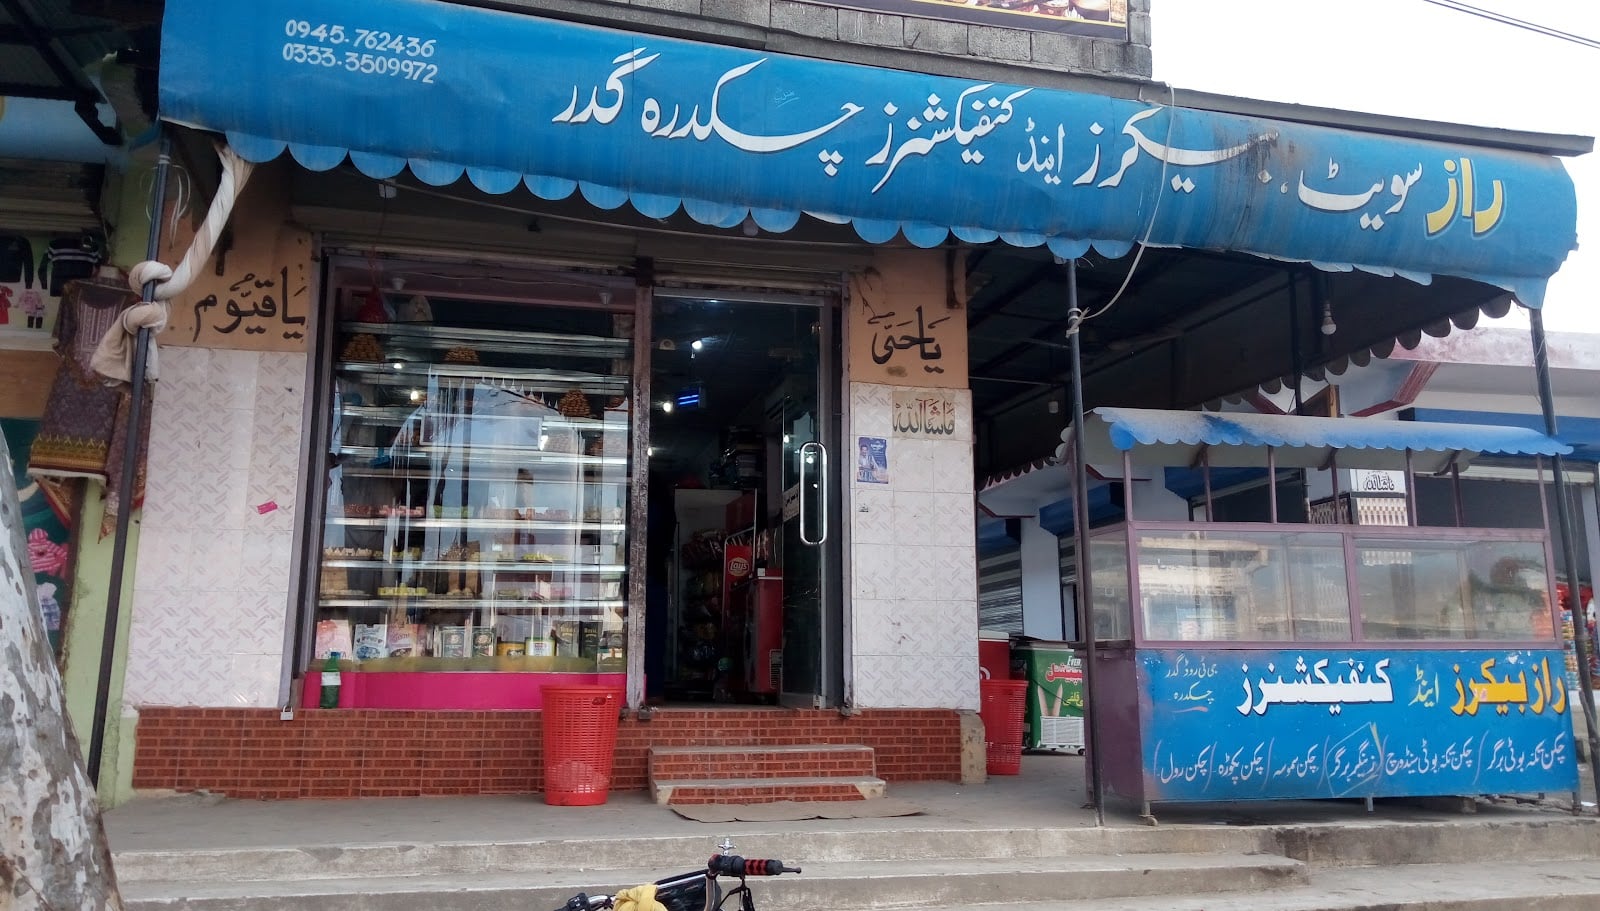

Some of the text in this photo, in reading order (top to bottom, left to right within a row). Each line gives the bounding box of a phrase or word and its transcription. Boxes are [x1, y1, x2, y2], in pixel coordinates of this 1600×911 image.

[551, 46, 661, 124] گدر
[641, 57, 866, 177] چکدرہ
[865, 83, 1035, 194] کنفیکشنرز
[1016, 117, 1067, 185] اینڈ
[1426, 157, 1504, 235] راز
[1173, 680, 1215, 705] چکدرہ
[1237, 656, 1567, 715] راز بیکرز اینڈ کنفیکشنرز
[1160, 751, 1184, 784] رول
[1185, 744, 1211, 782] چکن
[1240, 741, 1265, 781] چکن
[1296, 743, 1319, 778] چکن
[1450, 735, 1474, 771] چکن
[1541, 730, 1566, 771] چکن
